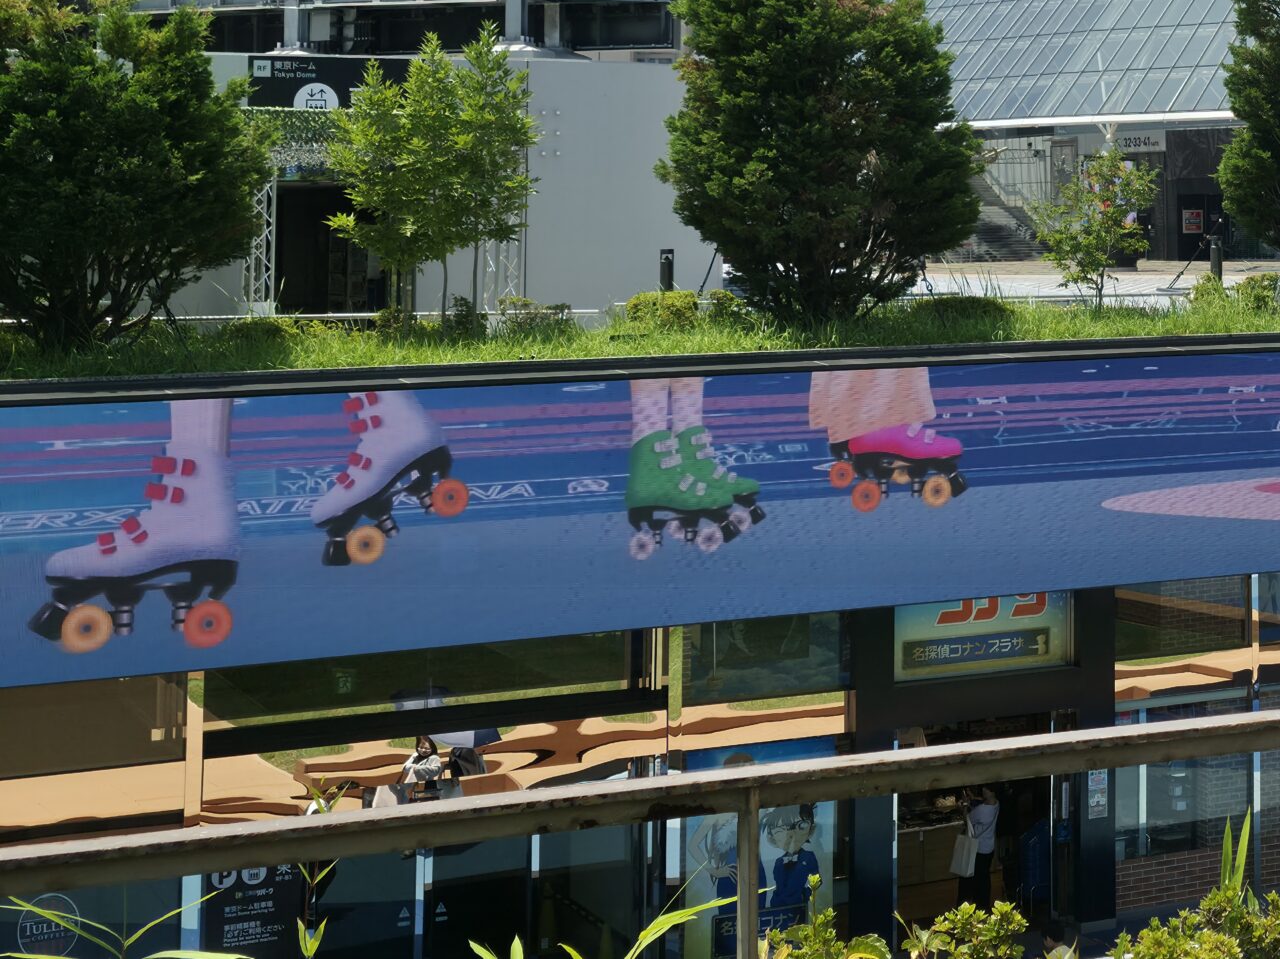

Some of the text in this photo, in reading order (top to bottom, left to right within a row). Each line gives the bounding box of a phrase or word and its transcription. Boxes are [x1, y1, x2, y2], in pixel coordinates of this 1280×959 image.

[273, 60, 316, 70] 東京ドーム
[273, 71, 295, 79] Tokyo
